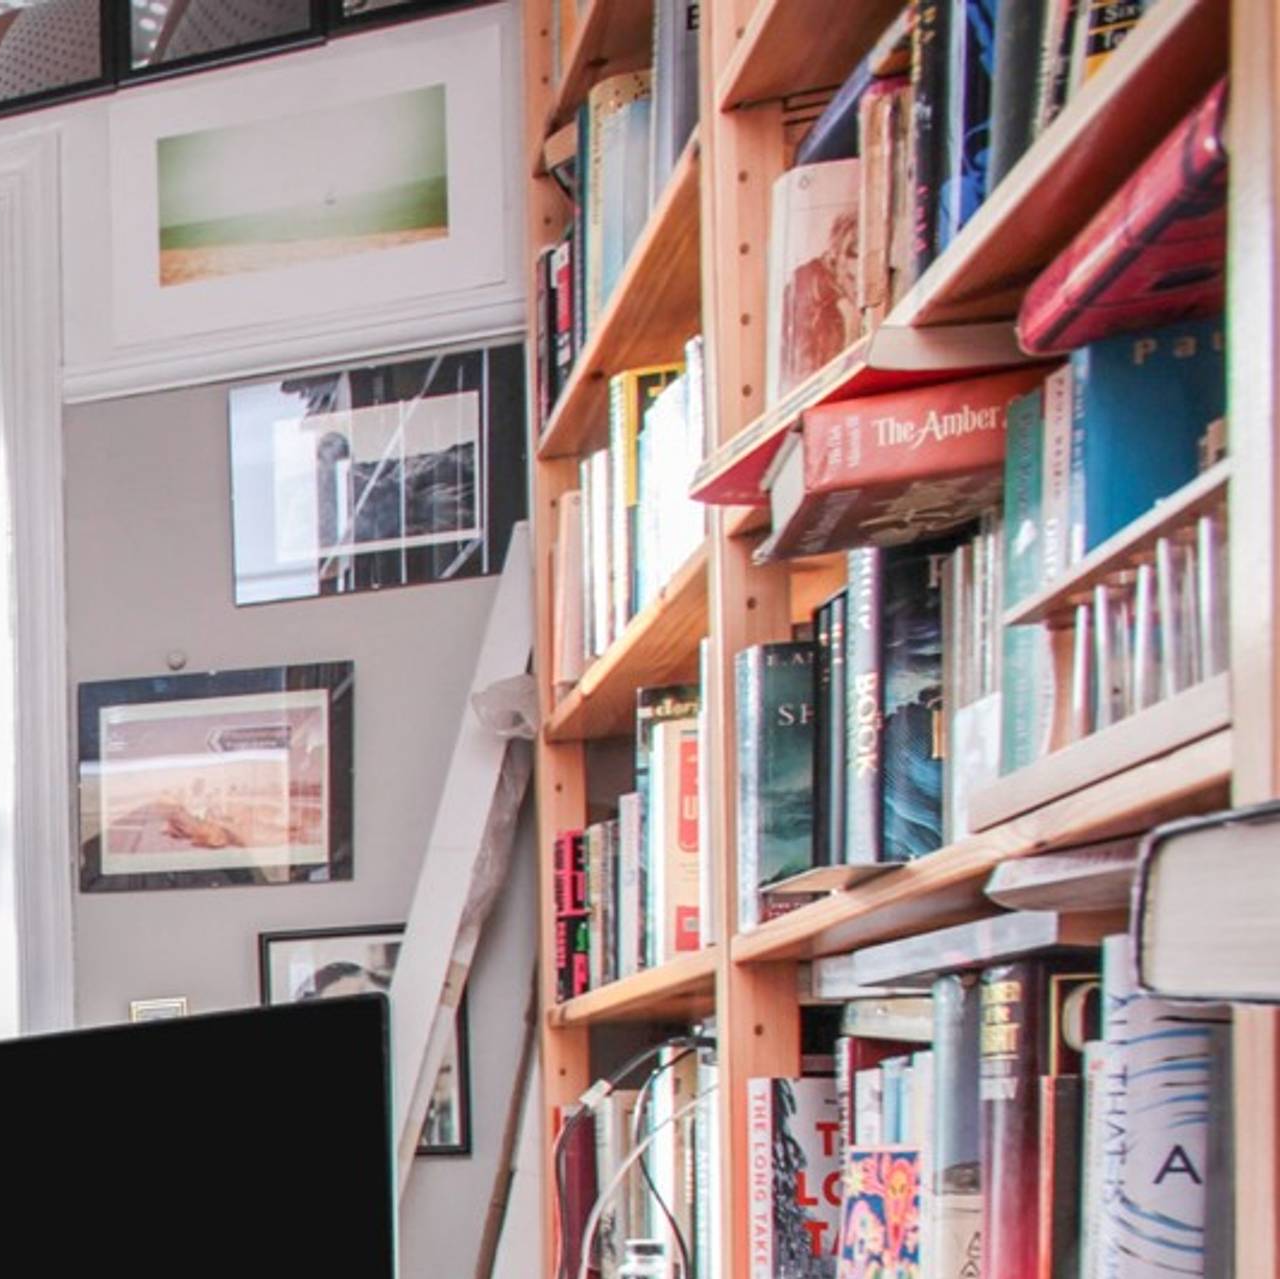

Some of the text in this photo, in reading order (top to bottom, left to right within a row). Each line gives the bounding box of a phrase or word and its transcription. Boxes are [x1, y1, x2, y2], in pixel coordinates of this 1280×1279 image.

[871, 415, 918, 447] The
[913, 408, 1002, 450] Amber
[1105, 1067, 1127, 1167] THAT
[754, 1092, 768, 1266] THE LONG TAKE
